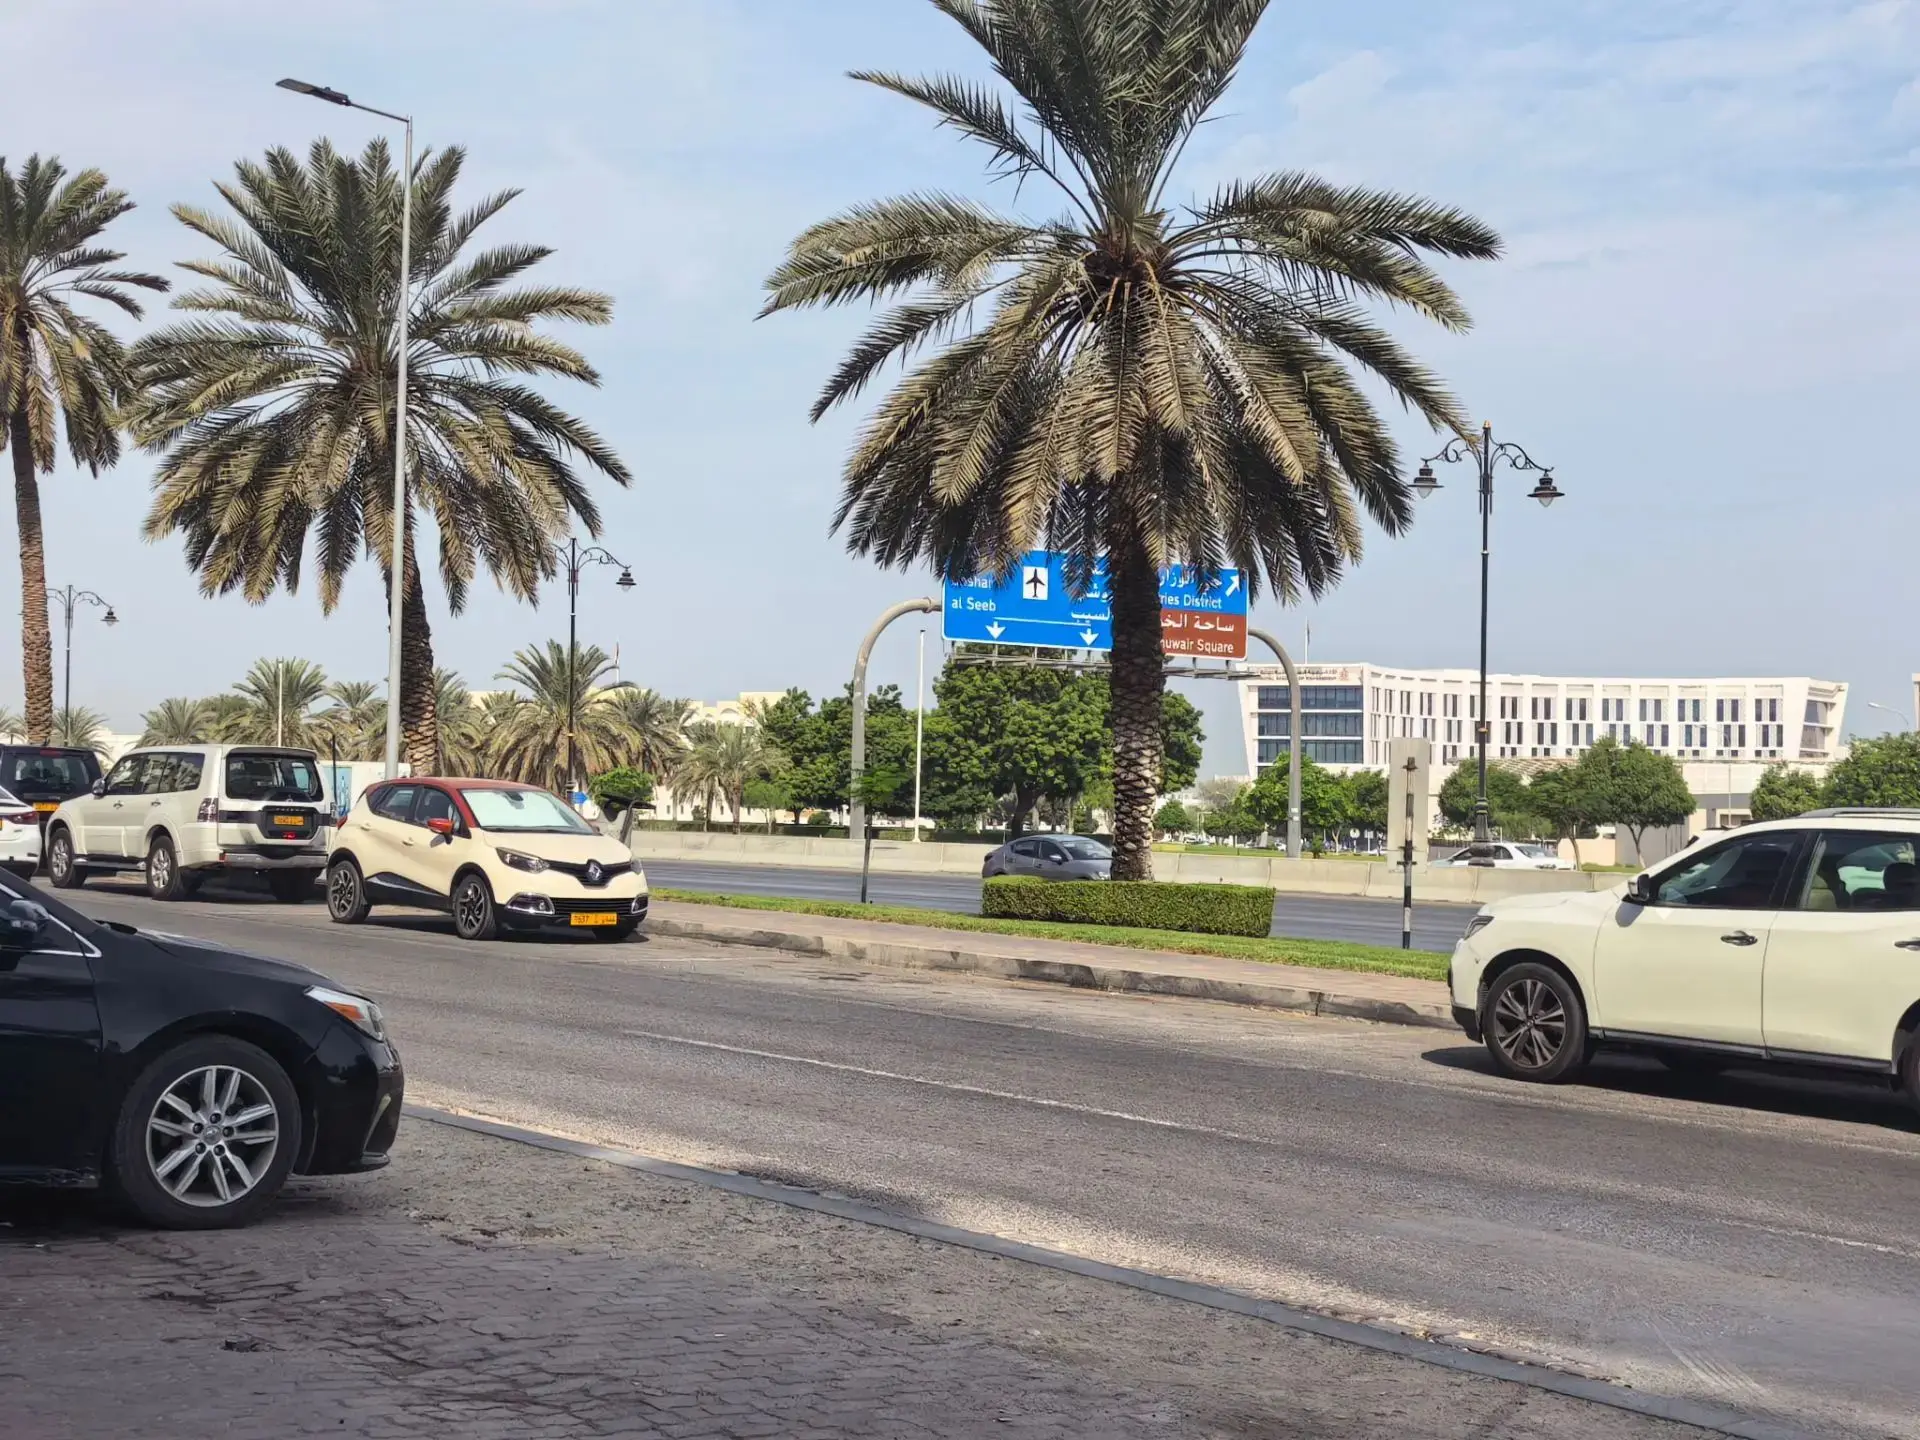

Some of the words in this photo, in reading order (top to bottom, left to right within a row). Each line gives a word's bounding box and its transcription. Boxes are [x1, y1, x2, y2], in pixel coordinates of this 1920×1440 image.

[951, 596, 963, 609] al
[966, 596, 996, 611] Seeb
[1183, 592, 1222, 609] District
[1071, 606, 1113, 624] لسيب
[1193, 615, 1235, 632] ساحة
[1197, 639, 1235, 654] Square
